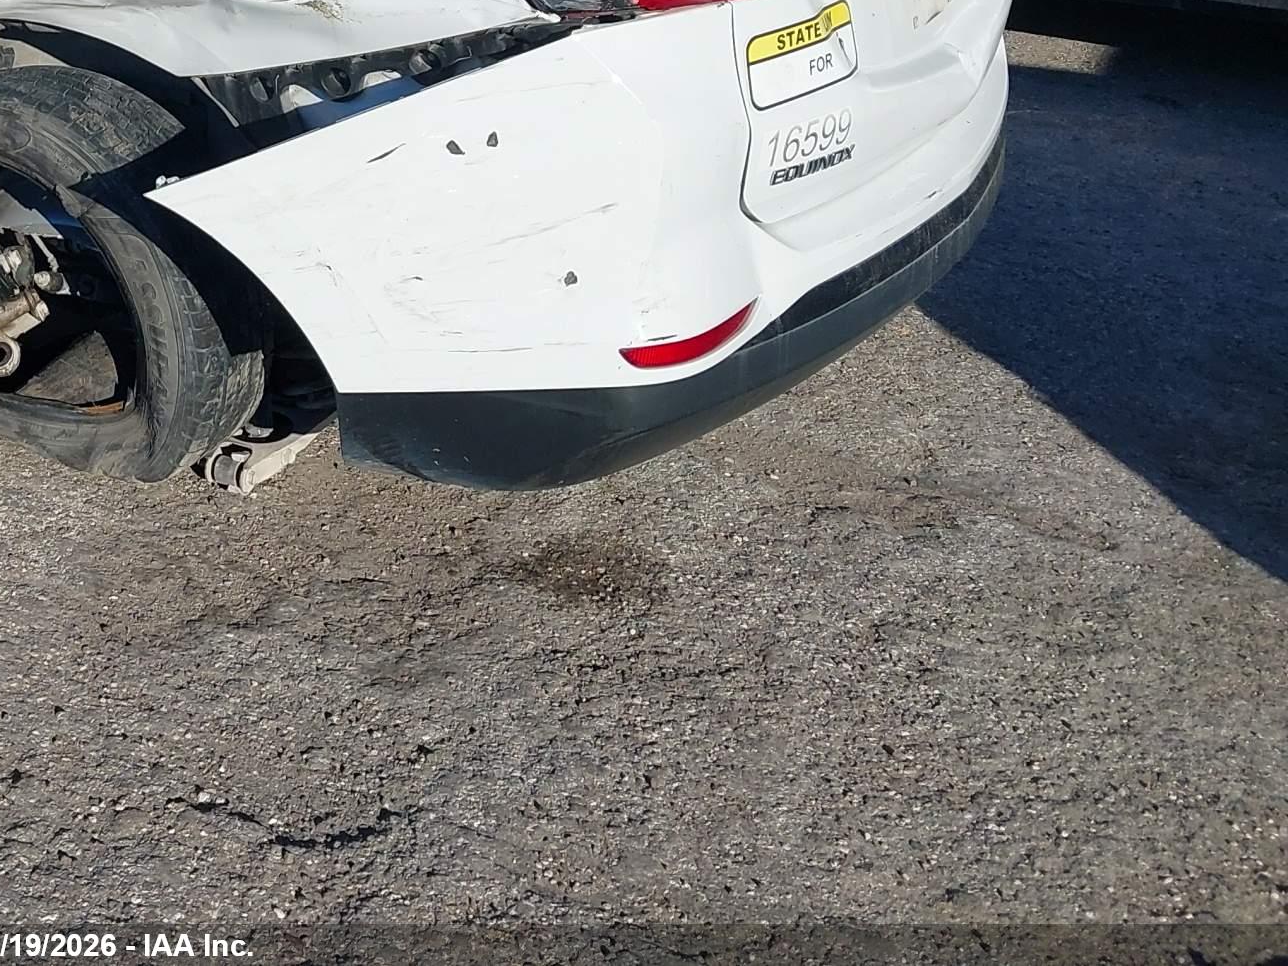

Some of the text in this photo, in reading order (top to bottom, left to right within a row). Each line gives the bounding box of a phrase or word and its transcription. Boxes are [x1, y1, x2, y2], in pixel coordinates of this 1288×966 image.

[776, 21, 822, 50] STATE
[808, 52, 834, 76] FOR
[768, 108, 852, 167] 16599
[770, 144, 856, 186] EQUINOX
